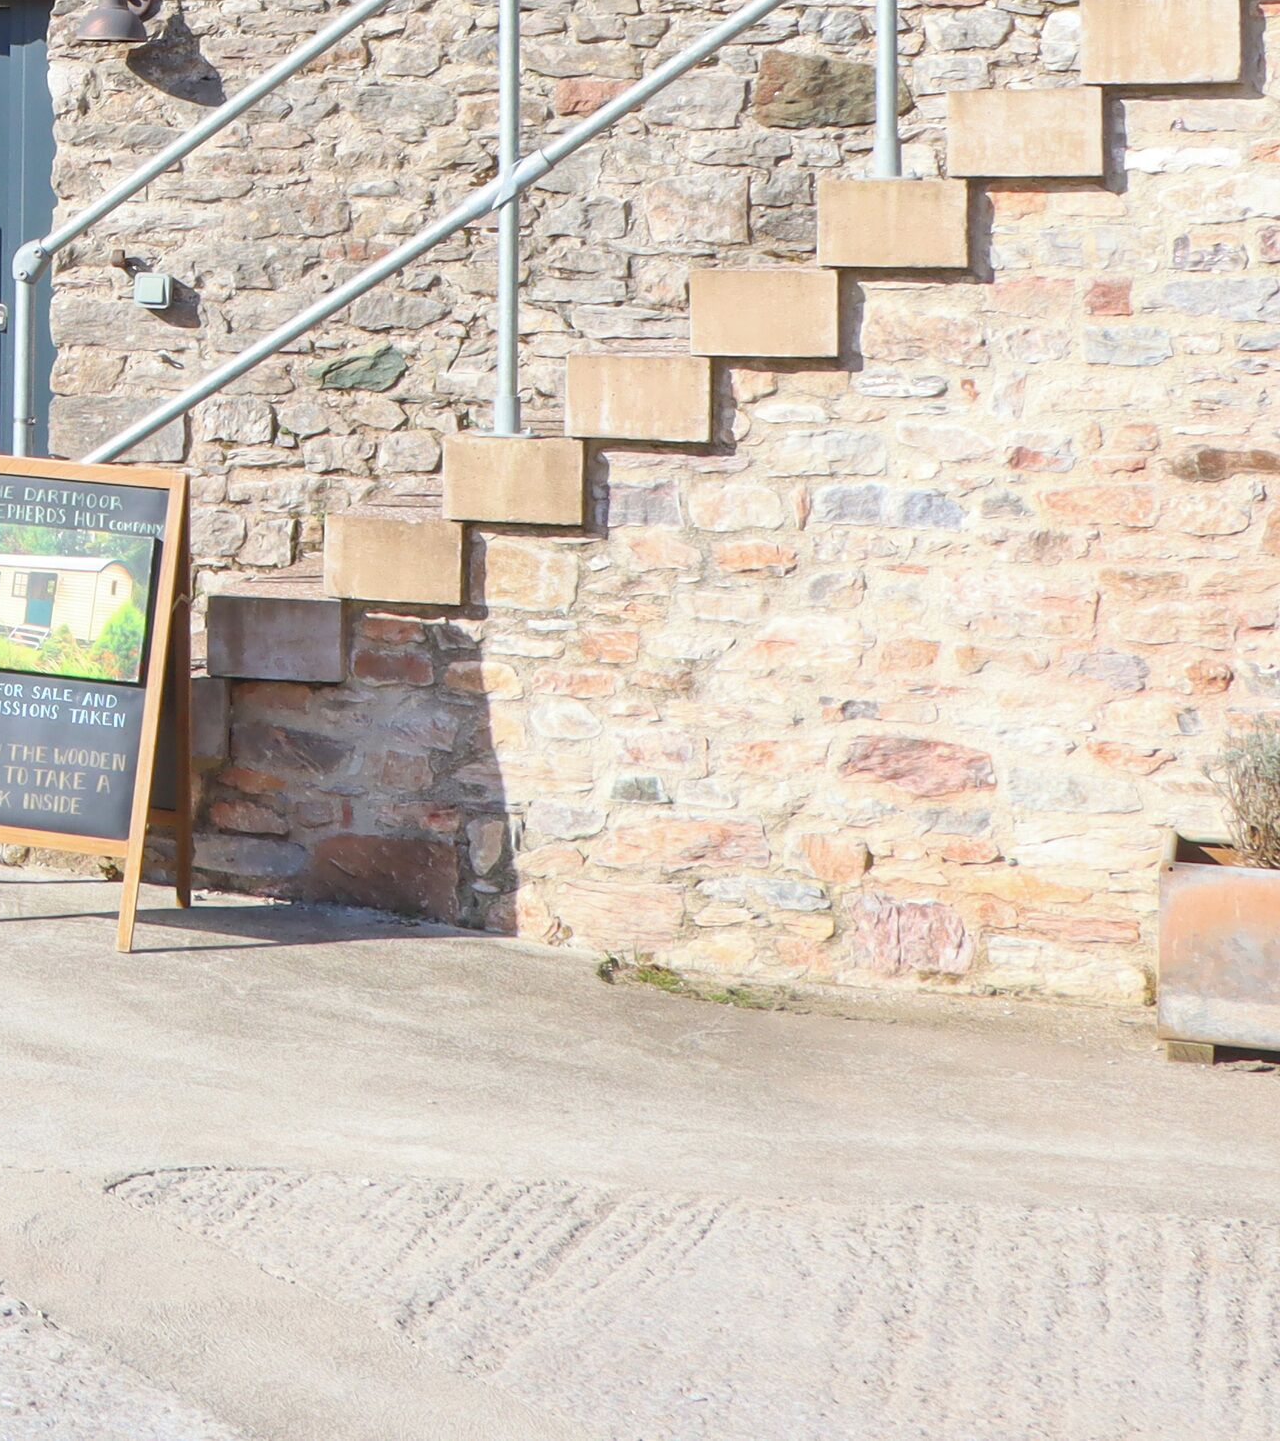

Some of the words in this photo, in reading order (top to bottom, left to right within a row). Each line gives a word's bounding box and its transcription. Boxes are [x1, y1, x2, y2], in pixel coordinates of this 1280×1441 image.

[24, 487, 123, 510] DARTMOOR
[74, 509, 110, 529] HUT
[109, 519, 164, 535] COMPANY
[31, 685, 73, 703] SALE
[81, 691, 118, 709] AND
[69, 708, 126, 728] TAKEN
[7, 743, 48, 764] THE
[53, 747, 127, 772] WOODEN
[3, 765, 28, 786] TO
[33, 768, 88, 791] TAKE
[96, 775, 111, 794] A
[23, 792, 84, 815] INSIDE
